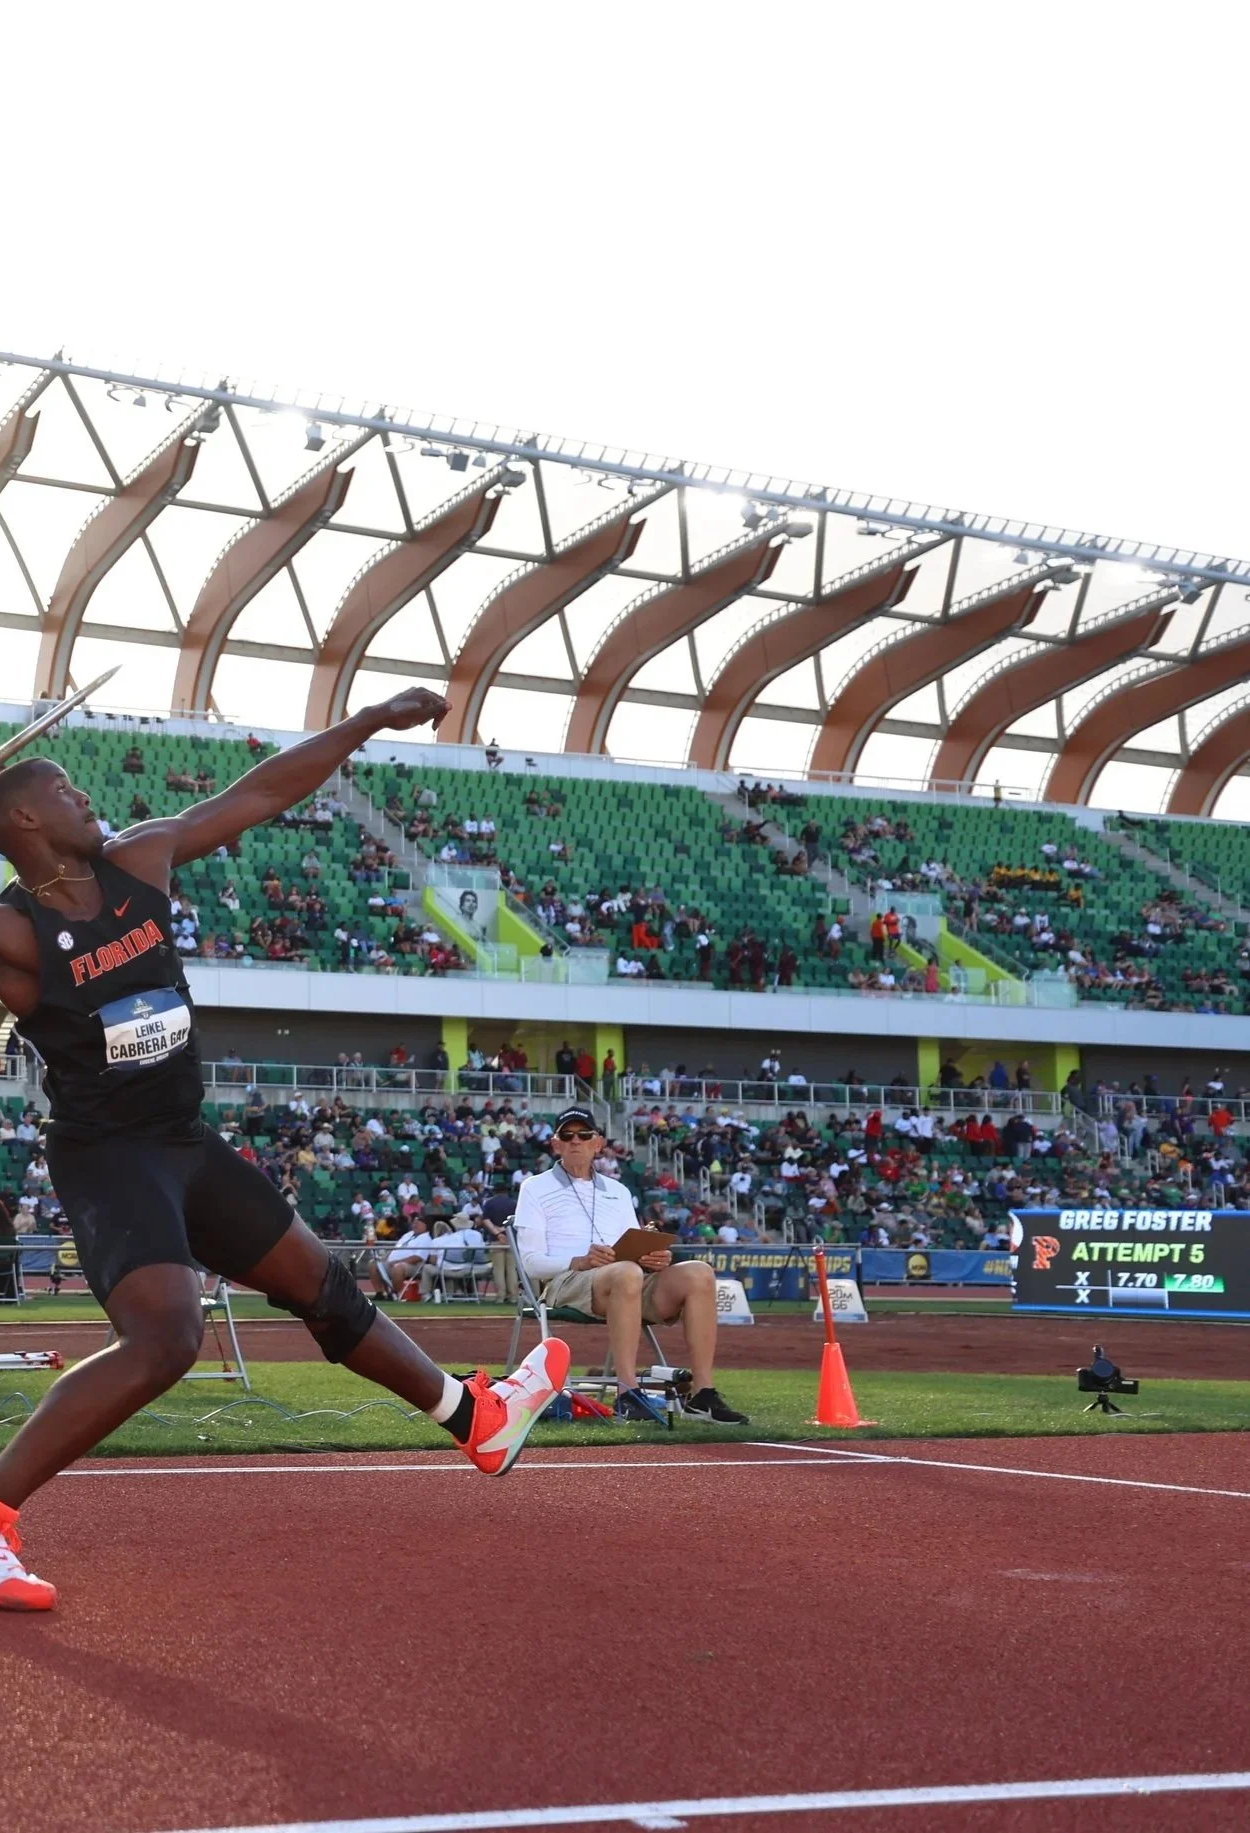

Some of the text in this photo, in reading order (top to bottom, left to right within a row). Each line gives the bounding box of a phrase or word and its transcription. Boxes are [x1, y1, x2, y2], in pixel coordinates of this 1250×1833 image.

[69, 918, 164, 987] FLORIDA
[135, 1020, 166, 1039] LEIKEL
[110, 1035, 168, 1060] CABRERA
[170, 1027, 188, 1046] GAY
[1059, 1211, 1213, 1232] GREG FOSTER
[1032, 1236, 1060, 1269] P
[1071, 1241, 1205, 1264] ATTEMPT 5
[1074, 1271, 1215, 1289] X 7.70 7.80
[717, 1289, 736, 1300] 8M
[1074, 1289, 1091, 1304] X
